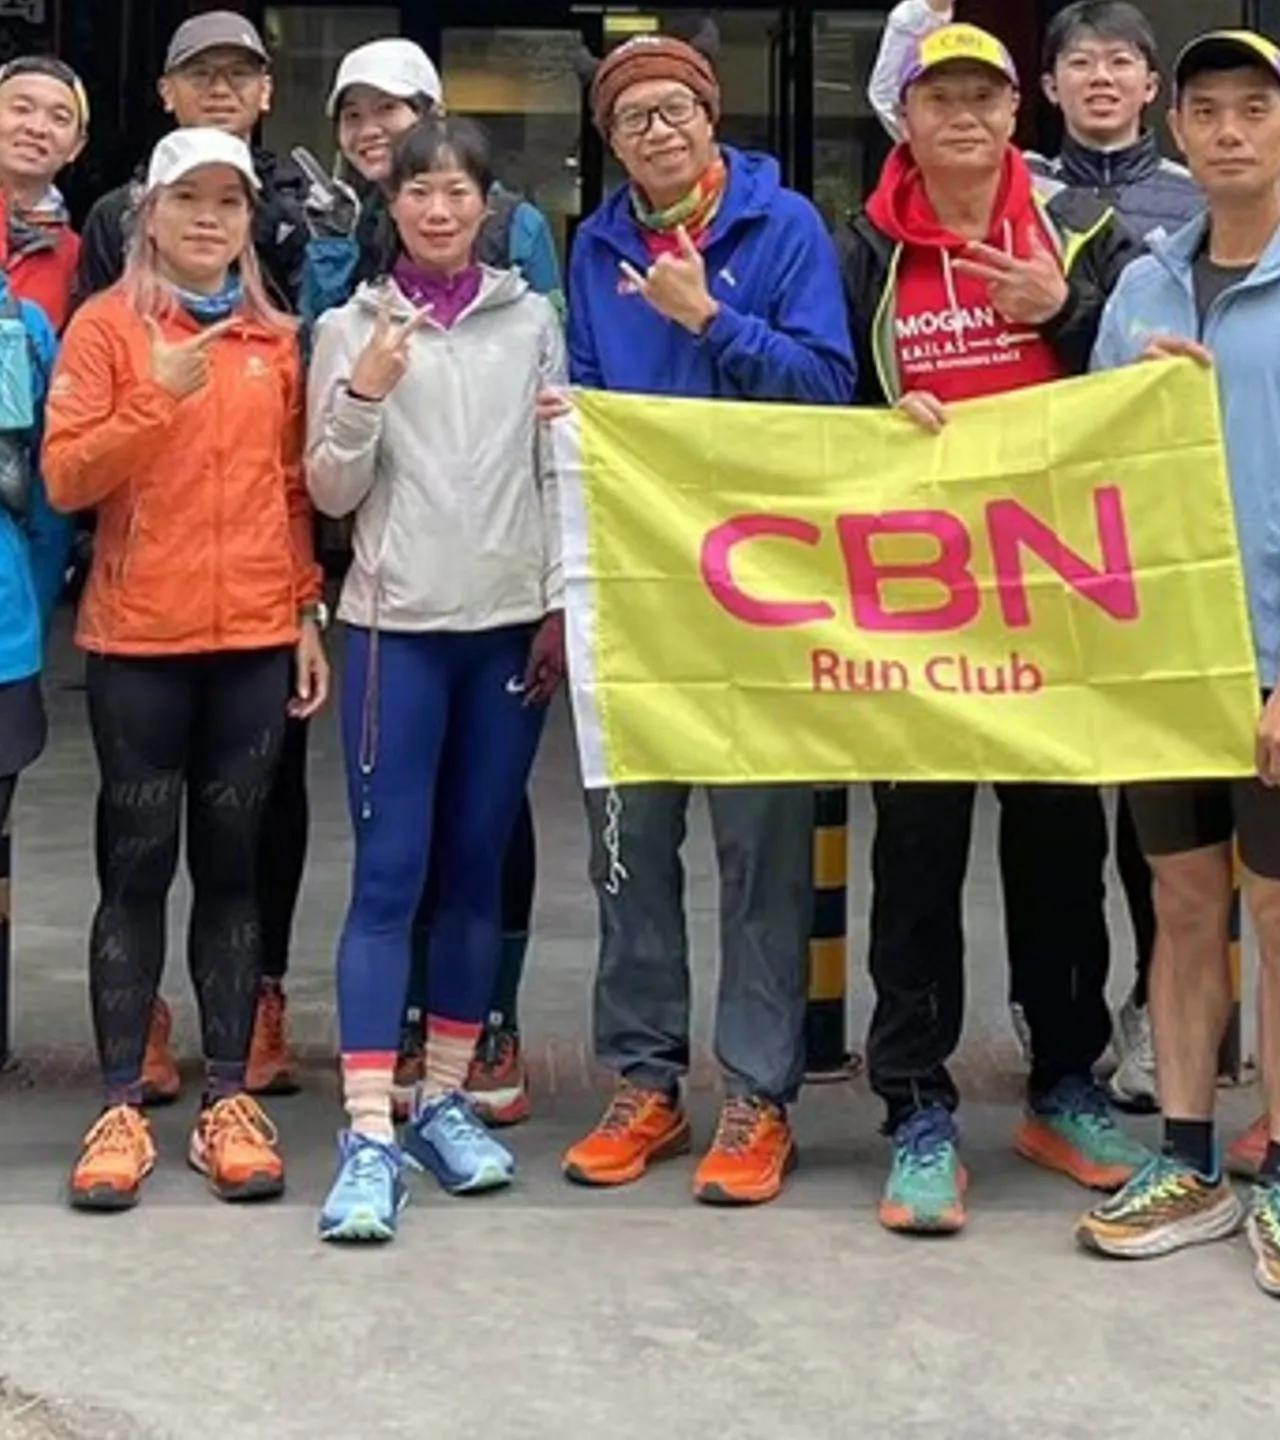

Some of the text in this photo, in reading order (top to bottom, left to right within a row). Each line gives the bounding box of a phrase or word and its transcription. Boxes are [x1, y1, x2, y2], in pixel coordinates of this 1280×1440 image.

[895, 308, 994, 338] MOGAN
[699, 484, 1141, 634] CBN
[811, 648, 1043, 694] Run Club
